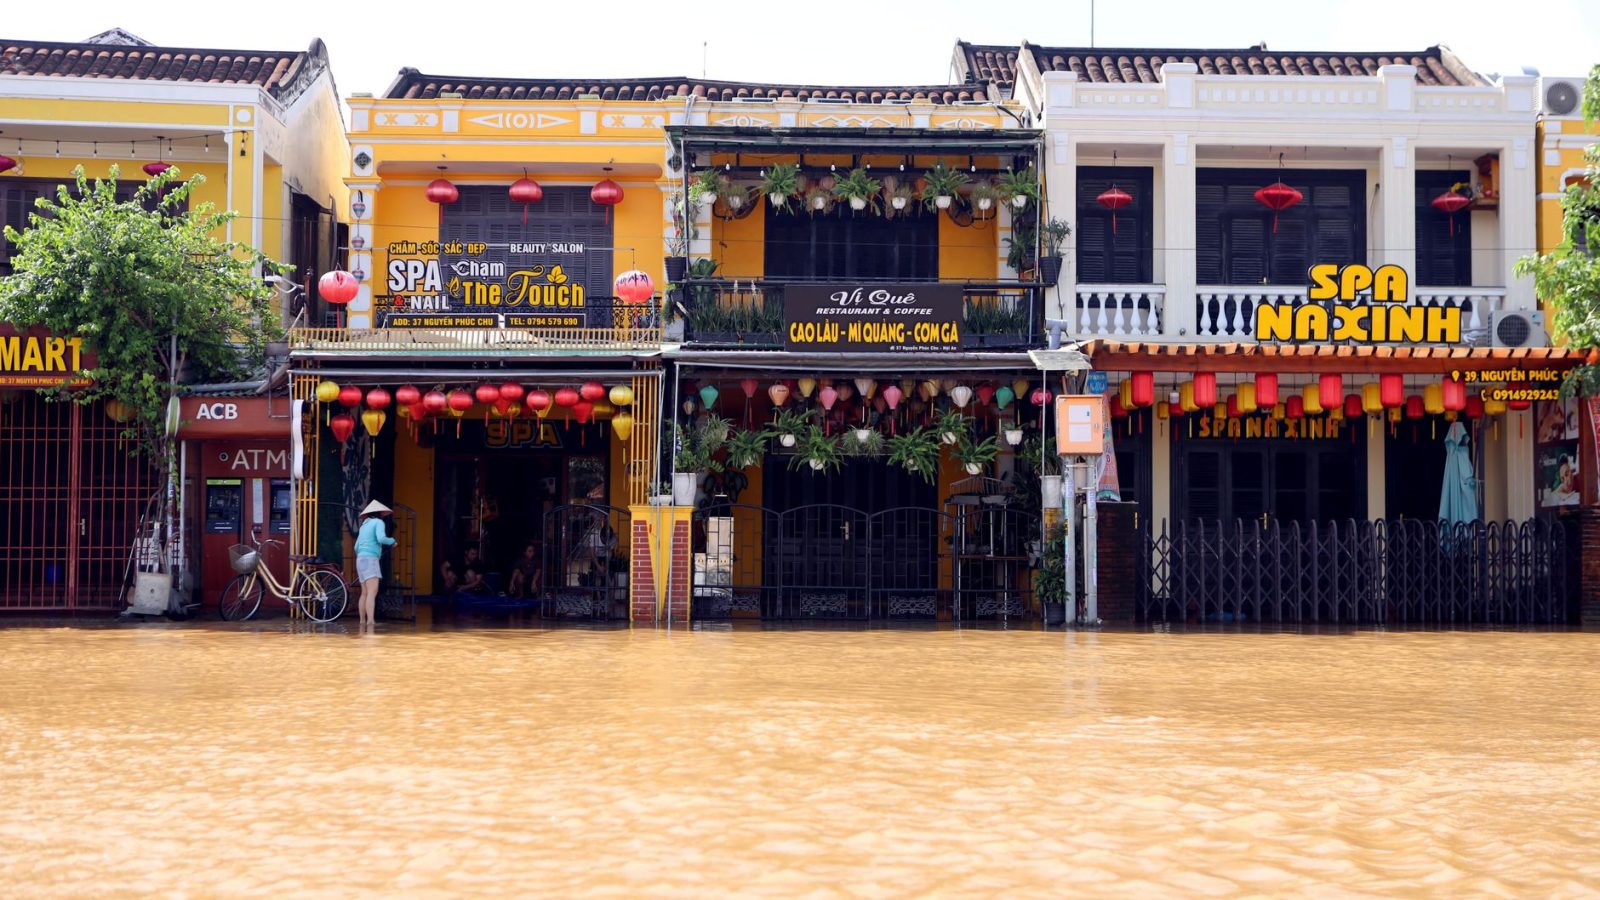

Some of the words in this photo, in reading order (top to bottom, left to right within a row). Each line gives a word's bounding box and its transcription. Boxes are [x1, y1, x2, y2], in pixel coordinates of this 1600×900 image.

[510, 243, 546, 253] BEAUTY
[552, 243, 583, 253] SALON
[388, 258, 443, 292] SPA
[451, 260, 505, 280] Chạm
[462, 281, 502, 305] The
[505, 264, 586, 307] Touch
[1308, 263, 1409, 302] SPA
[394, 294, 404, 306] &
[410, 295, 451, 310] NAIL
[830, 287, 864, 306] Vị
[868, 289, 917, 306] Quê
[412, 318, 422, 326] 37
[477, 318, 494, 326] CHU
[510, 317, 526, 325] TEL:
[527, 317, 546, 325] 0794
[547, 317, 562, 325] 579
[563, 317, 578, 326] 690
[789, 321, 816, 343] CAO
[0, 336, 82, 372] MART
[1464, 371, 1477, 381] 39
[1529, 367, 1558, 381] PHÚC
[1493, 389, 1559, 400] 0914929243
[196, 402, 238, 420] ACB
[485, 420, 563, 448] SPA
[1199, 416, 1241, 438] SPA
[231, 449, 287, 471] ATM
